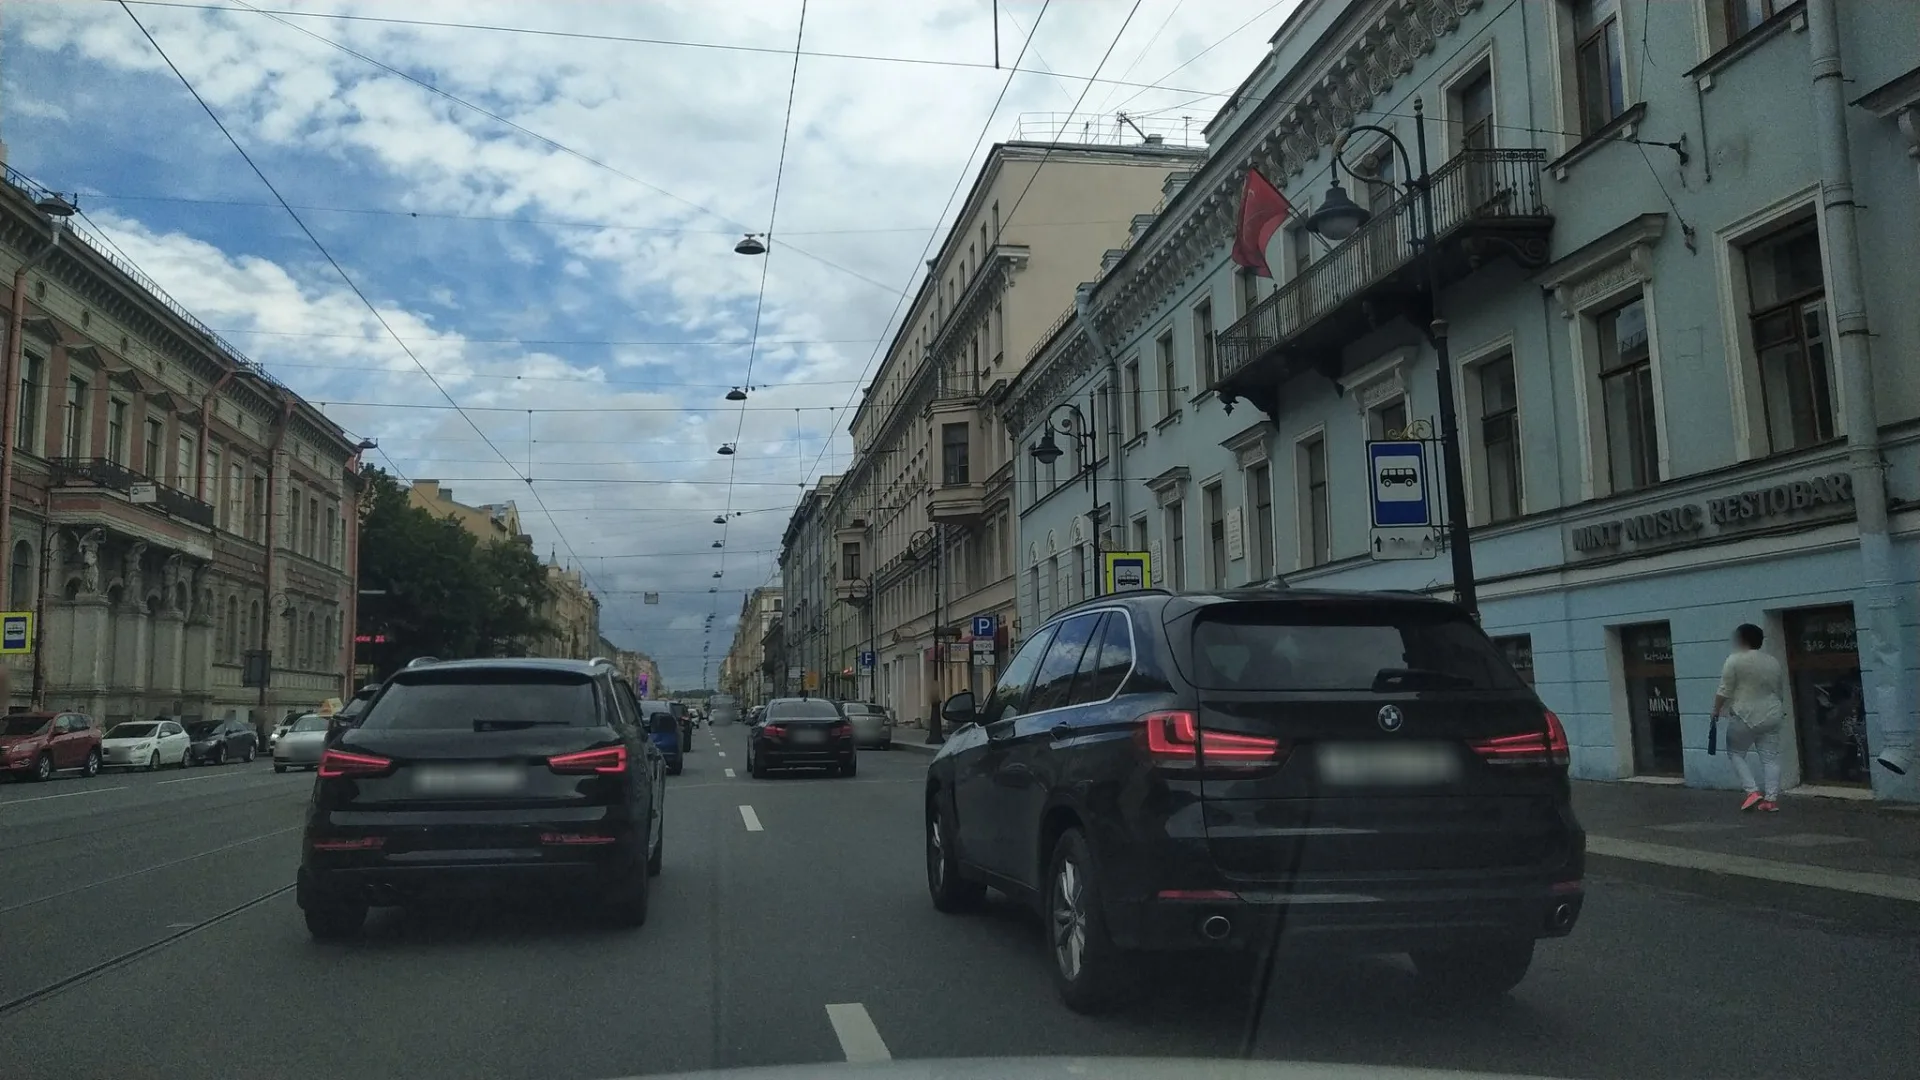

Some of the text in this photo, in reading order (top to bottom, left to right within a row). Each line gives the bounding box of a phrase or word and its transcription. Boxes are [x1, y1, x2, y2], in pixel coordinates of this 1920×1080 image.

[1572, 473, 1851, 552] MINT MUSIC RESTOBAR
[979, 618, 990, 635] P
[1649, 697, 1675, 712] MINT
